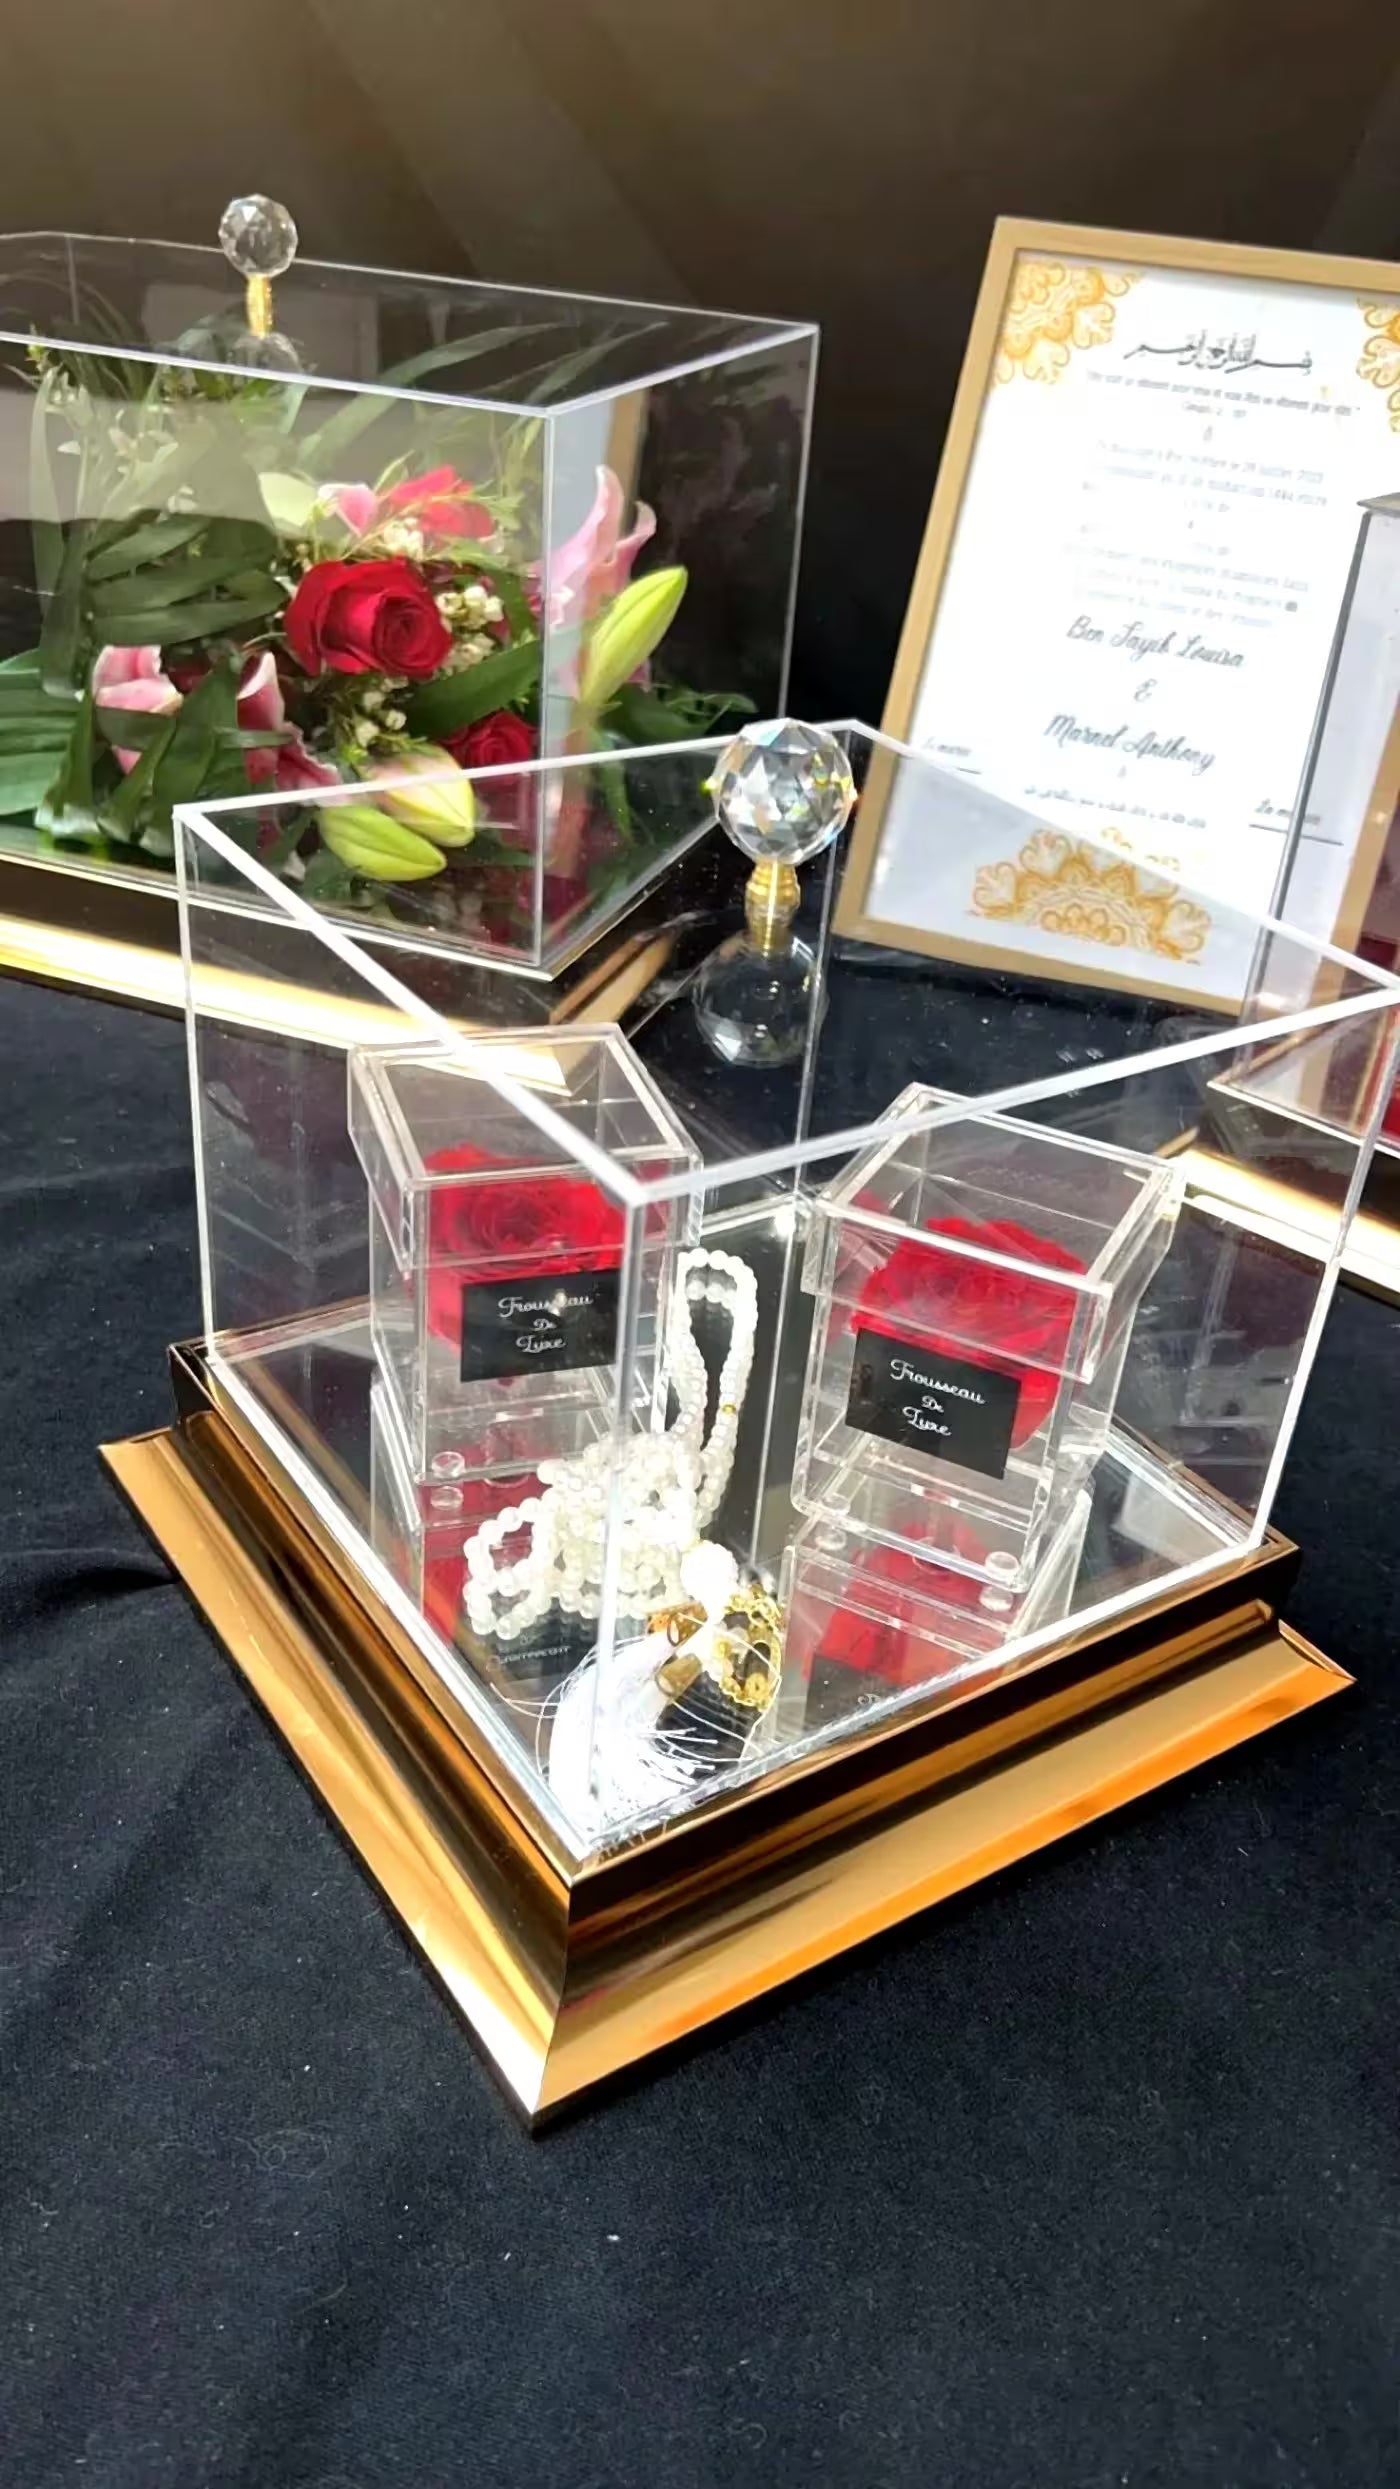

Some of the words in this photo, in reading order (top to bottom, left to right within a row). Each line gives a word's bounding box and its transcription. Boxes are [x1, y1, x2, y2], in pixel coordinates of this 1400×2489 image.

[515, 1333, 566, 1354] Luxe
[889, 1358, 987, 1405] Trousseau
[902, 1405, 953, 1438] Luxe
